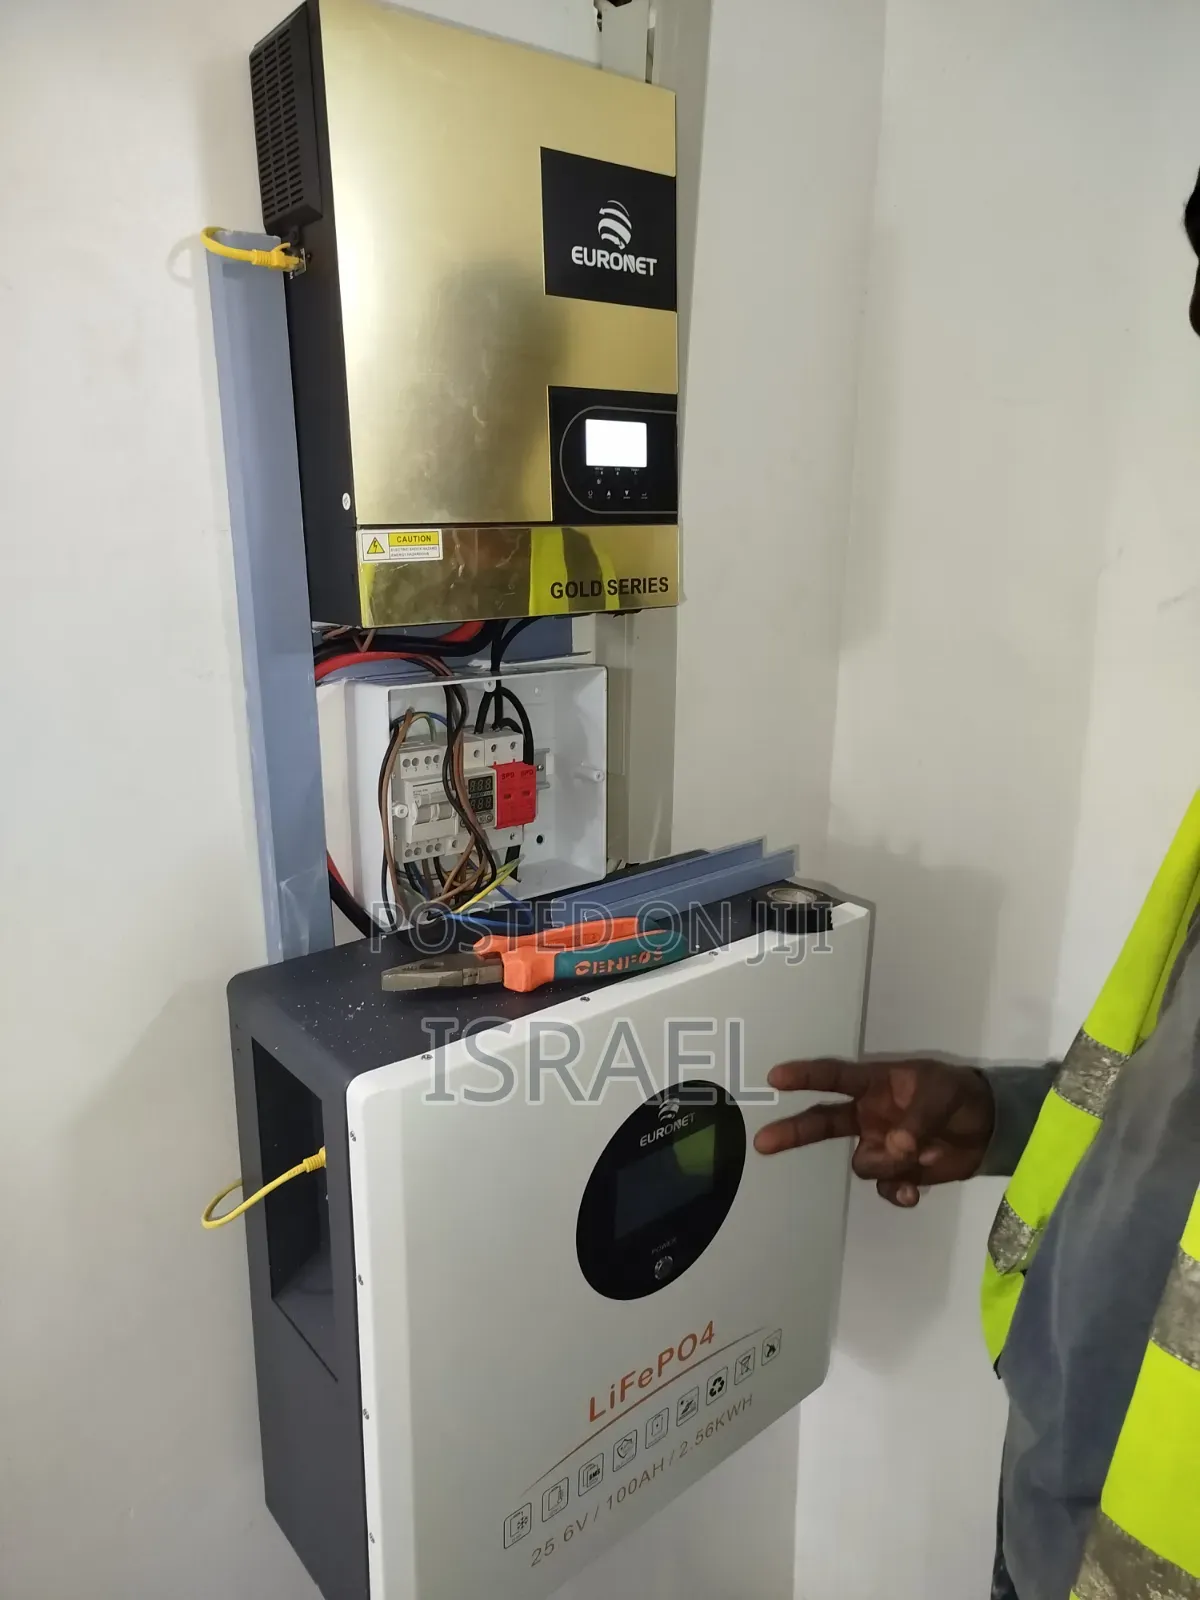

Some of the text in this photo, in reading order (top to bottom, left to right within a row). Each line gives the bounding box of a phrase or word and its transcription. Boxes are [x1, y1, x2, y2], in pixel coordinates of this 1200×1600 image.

[571, 245, 658, 276] EURONET
[396, 535, 432, 543] CAUTION
[550, 576, 669, 599] GOLD SERIES
[639, 1111, 696, 1147] EURONET
[589, 1320, 716, 1423] LiFePO4
[530, 1512, 588, 1568] 256V
[606, 1457, 665, 1511] 100AH
[678, 1393, 754, 1460] 2.56KWH
